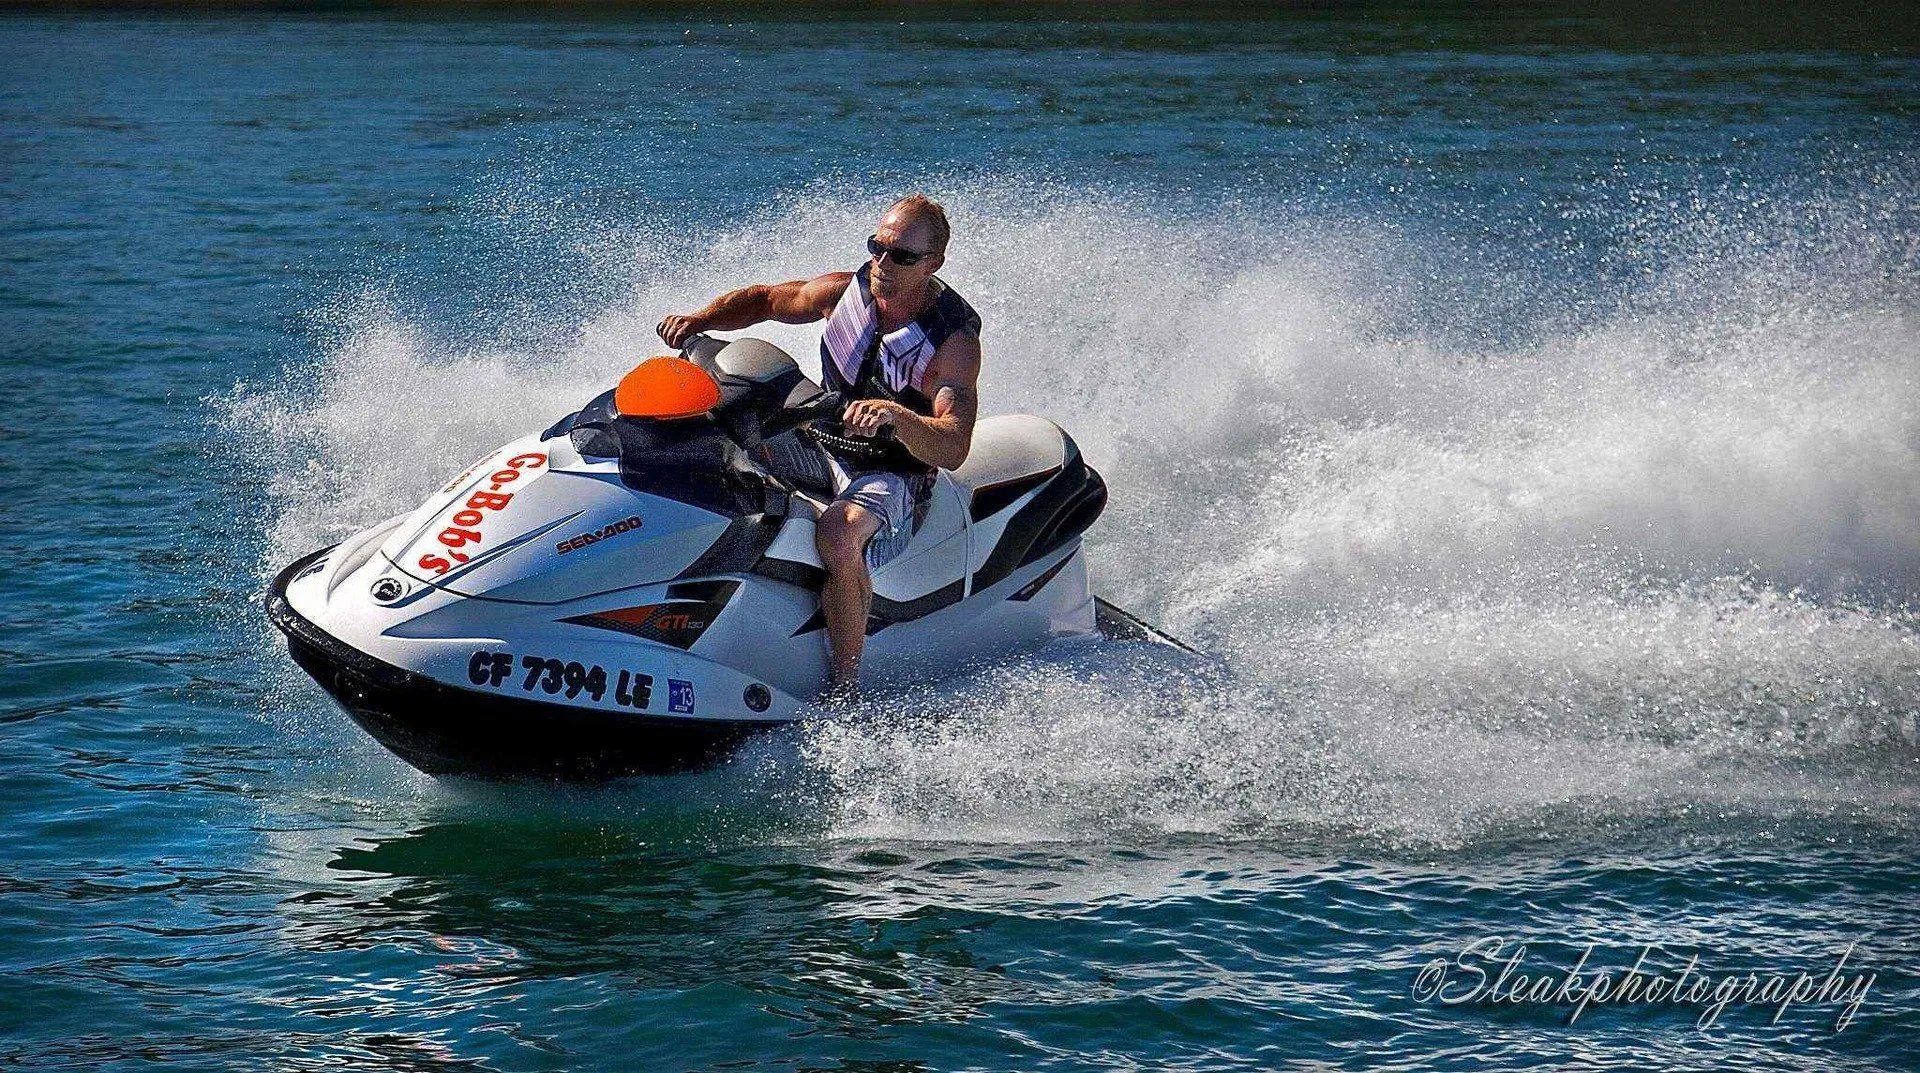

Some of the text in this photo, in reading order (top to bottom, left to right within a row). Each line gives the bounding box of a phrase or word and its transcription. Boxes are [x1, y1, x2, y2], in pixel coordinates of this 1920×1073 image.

[418, 452, 548, 575] Go-Bob's
[468, 650, 654, 710] CF 7394 LE
